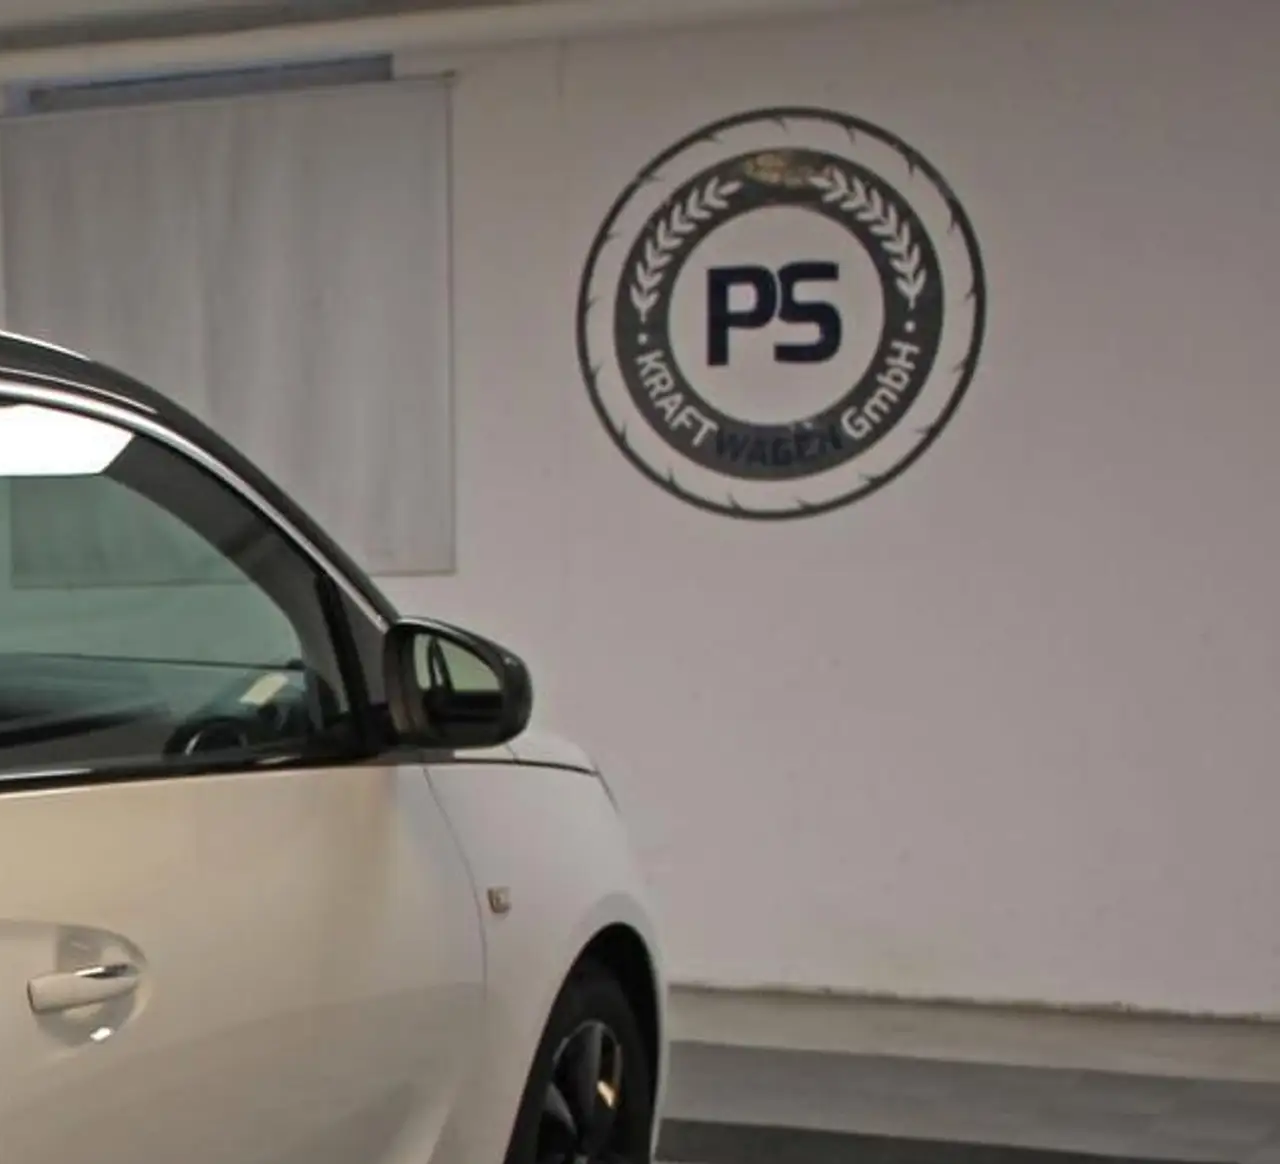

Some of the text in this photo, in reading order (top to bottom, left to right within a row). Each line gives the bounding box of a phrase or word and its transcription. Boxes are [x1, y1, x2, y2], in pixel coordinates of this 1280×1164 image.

[706, 261, 844, 367] PS
[635, 350, 719, 447] KRAFT
[841, 341, 920, 440] GmbH
